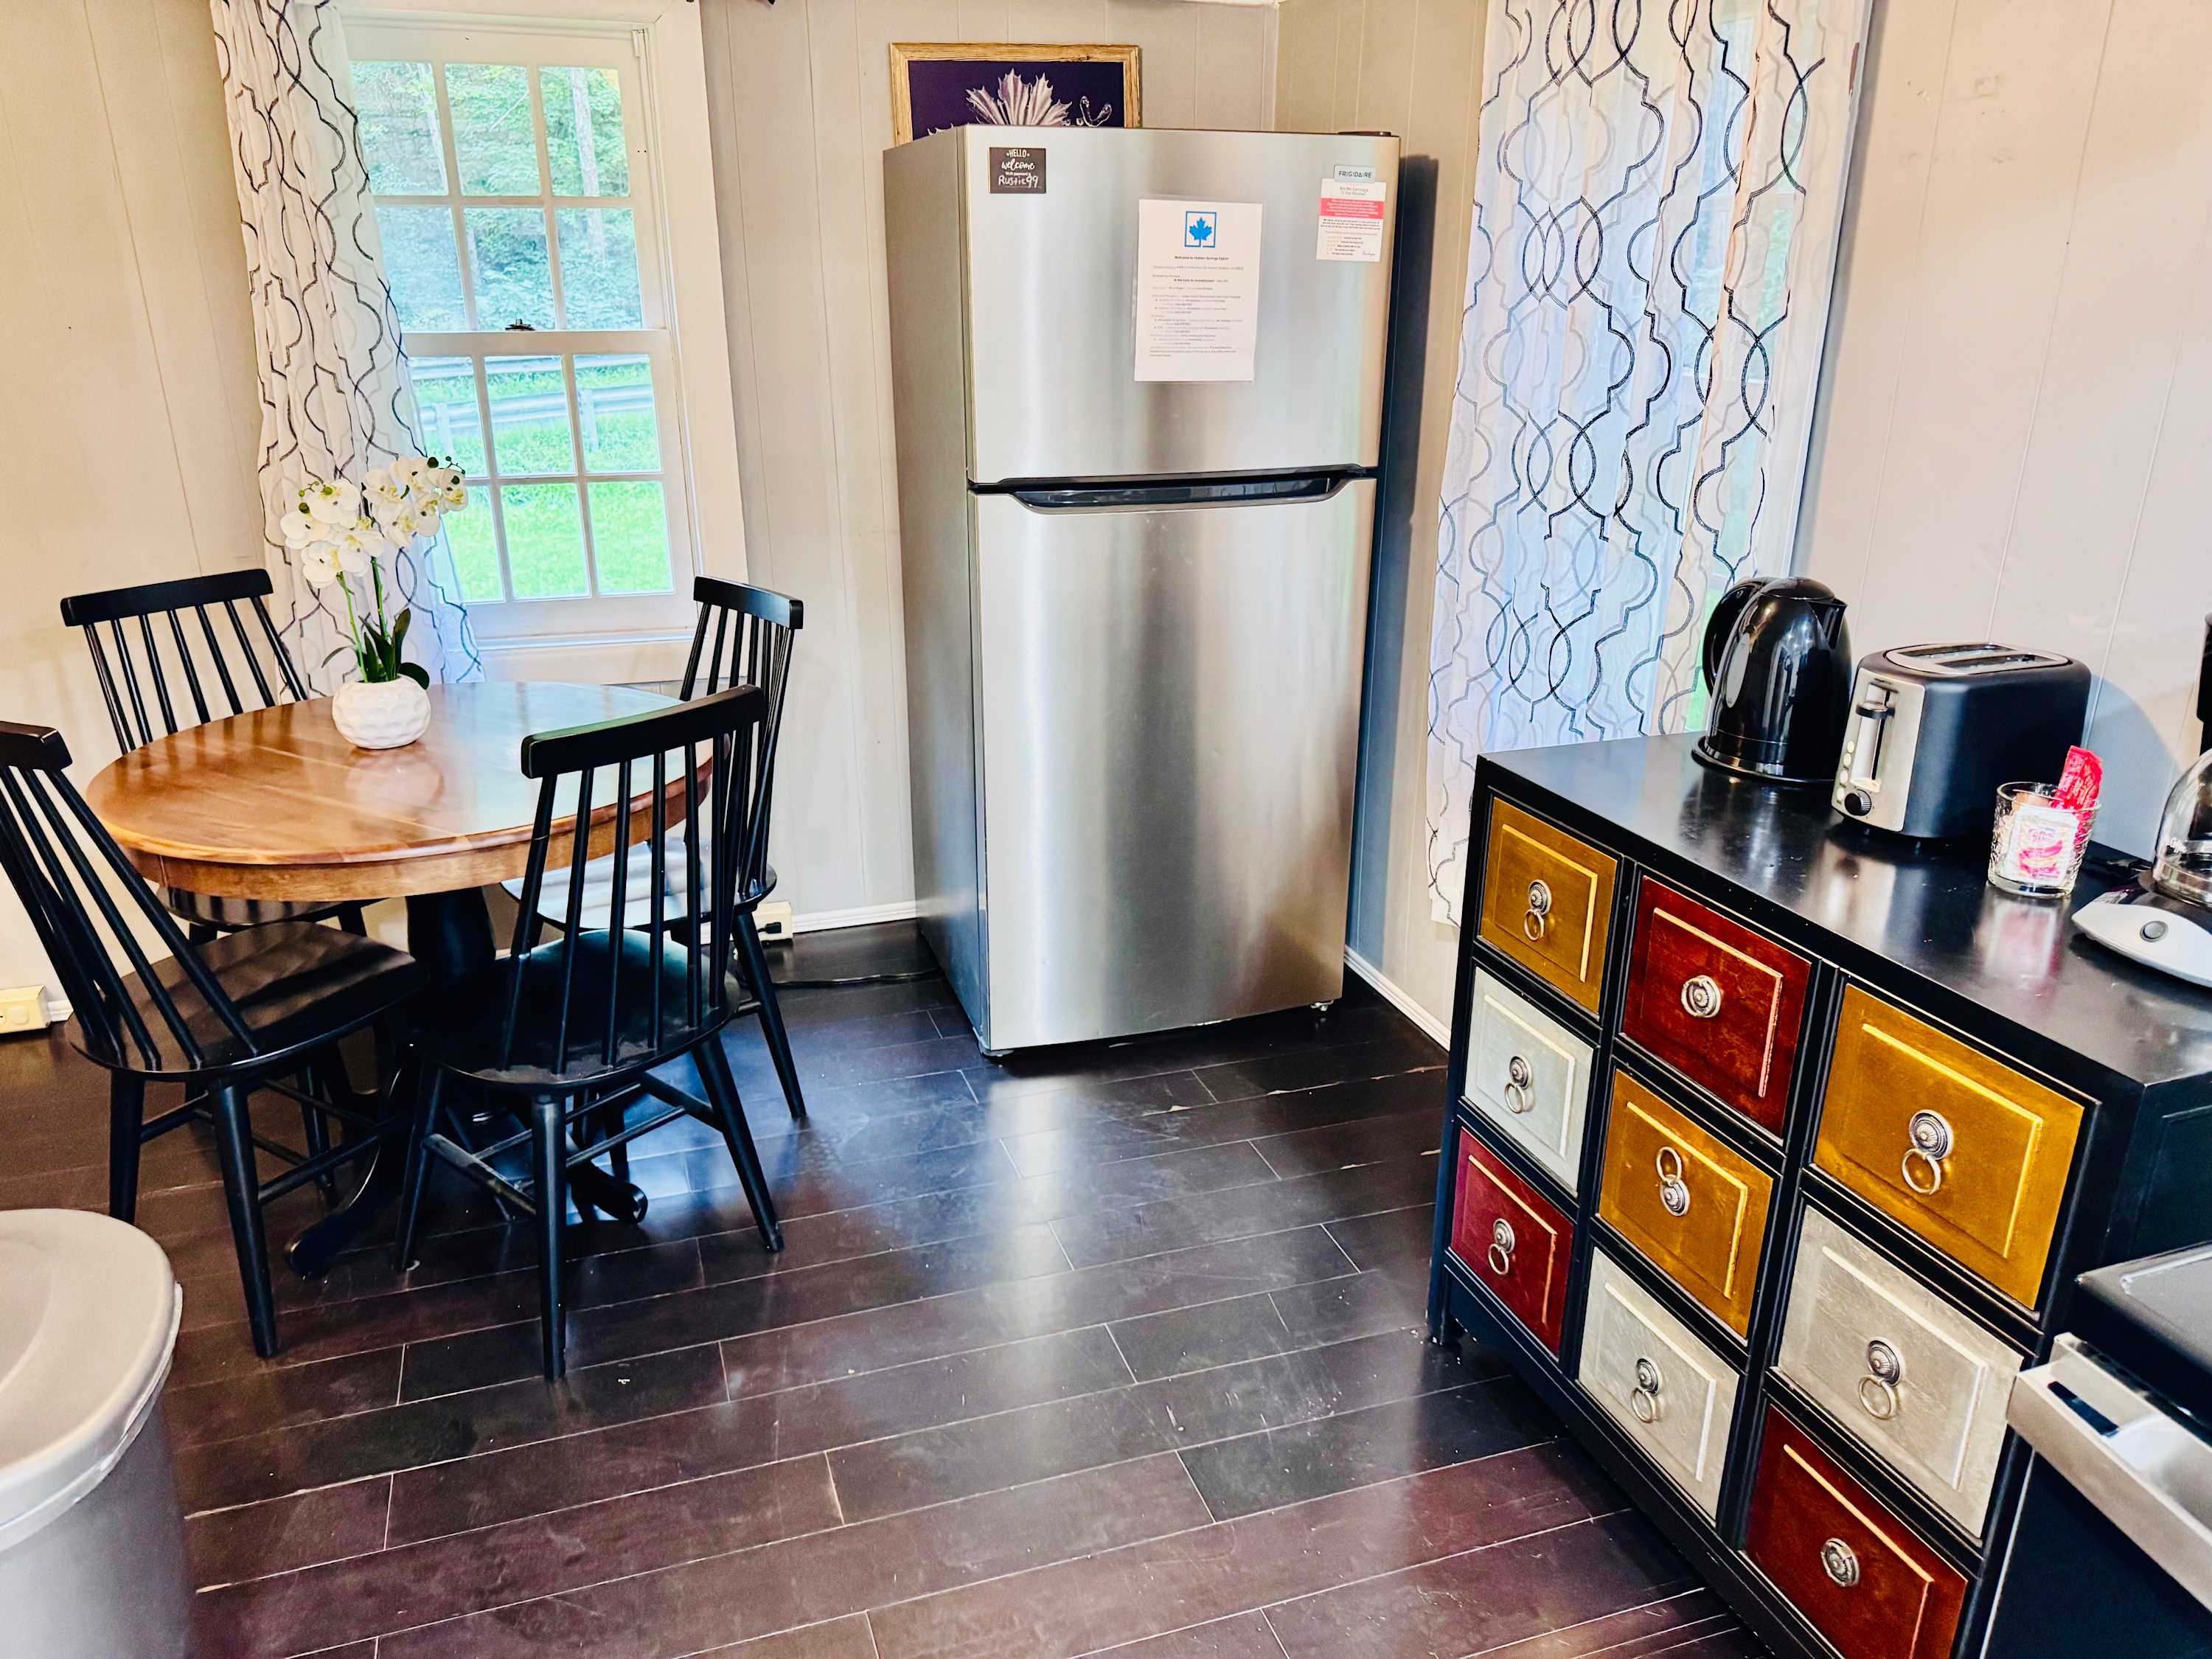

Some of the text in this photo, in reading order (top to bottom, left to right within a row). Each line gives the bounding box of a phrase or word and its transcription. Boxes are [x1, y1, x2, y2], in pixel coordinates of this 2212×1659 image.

[1009, 149, 1027, 158] HELLO
[1001, 158, 1035, 171] welcome
[1338, 170, 1372, 178] FRIGIDAIRE
